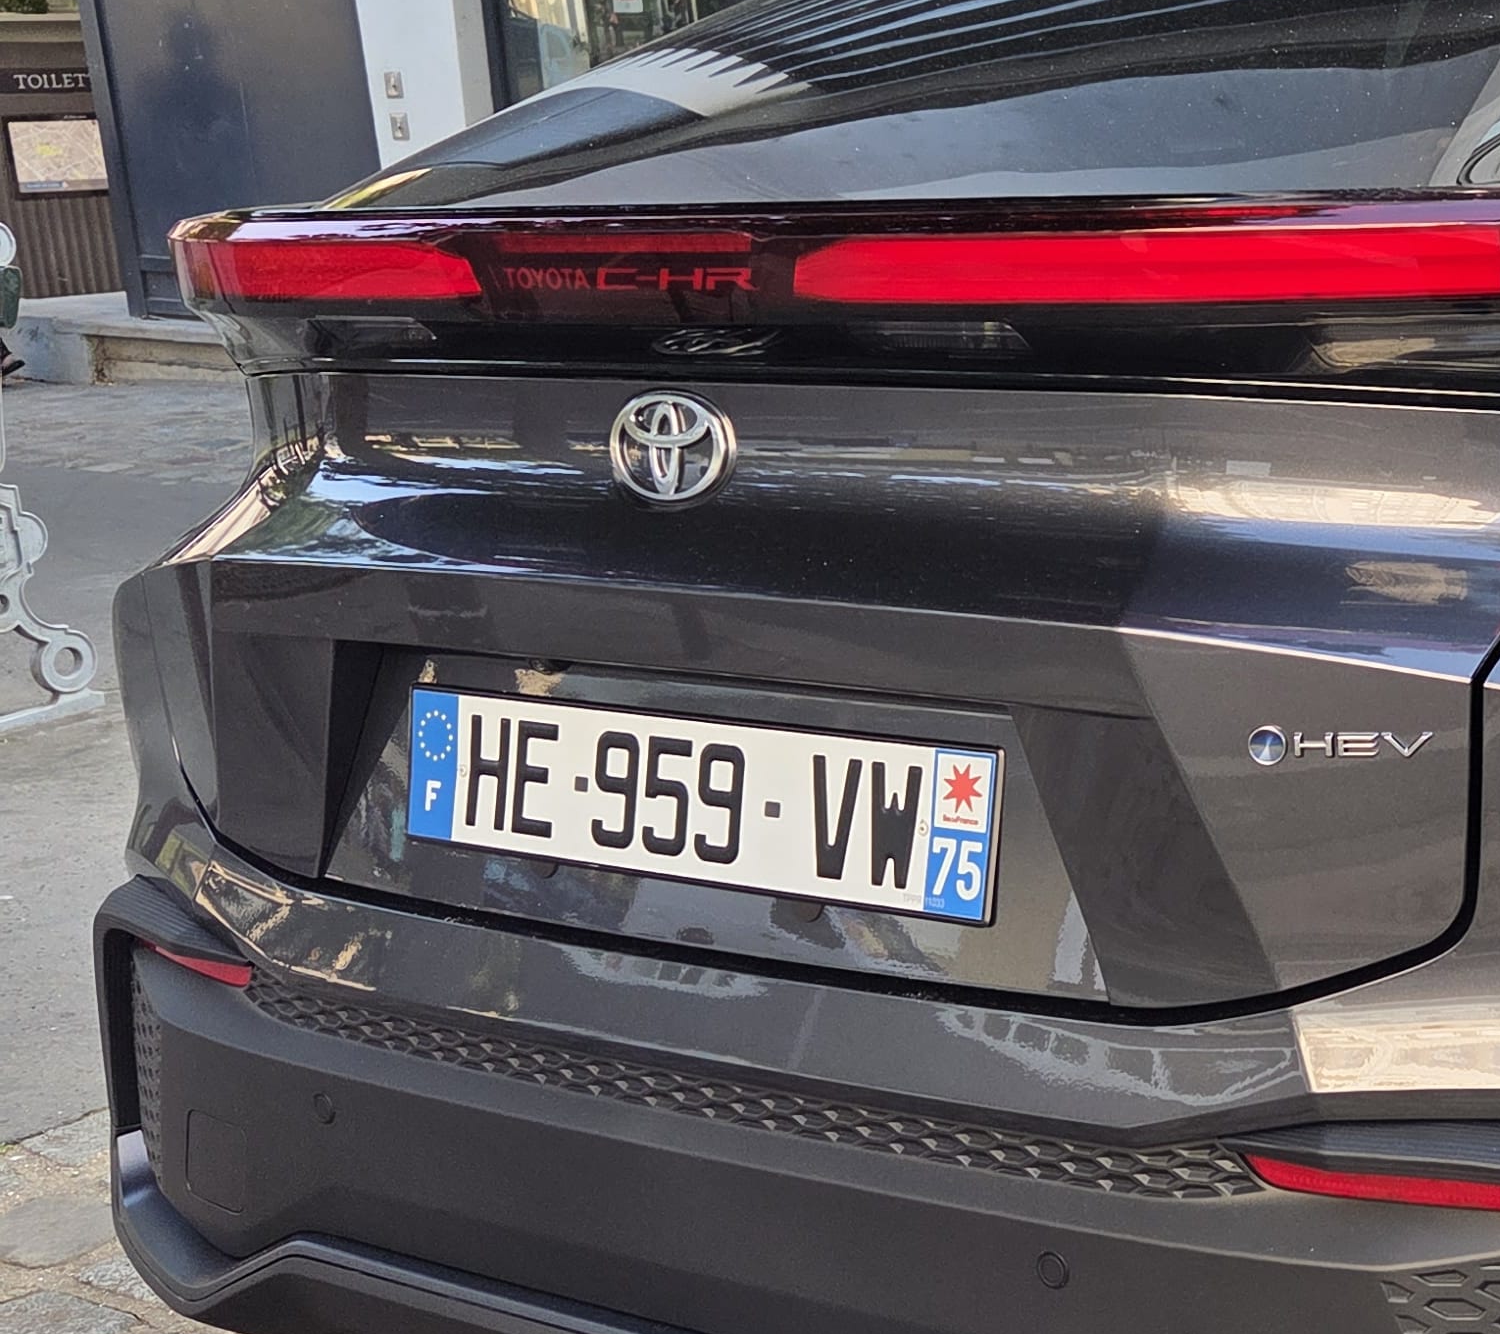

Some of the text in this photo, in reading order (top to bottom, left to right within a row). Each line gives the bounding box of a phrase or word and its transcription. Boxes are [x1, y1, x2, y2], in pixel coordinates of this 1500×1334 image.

[505, 267, 760, 292] TOYOTA C-HR
[1293, 731, 1434, 758] HEV
[423, 779, 442, 812] F
[931, 836, 984, 902] 75
